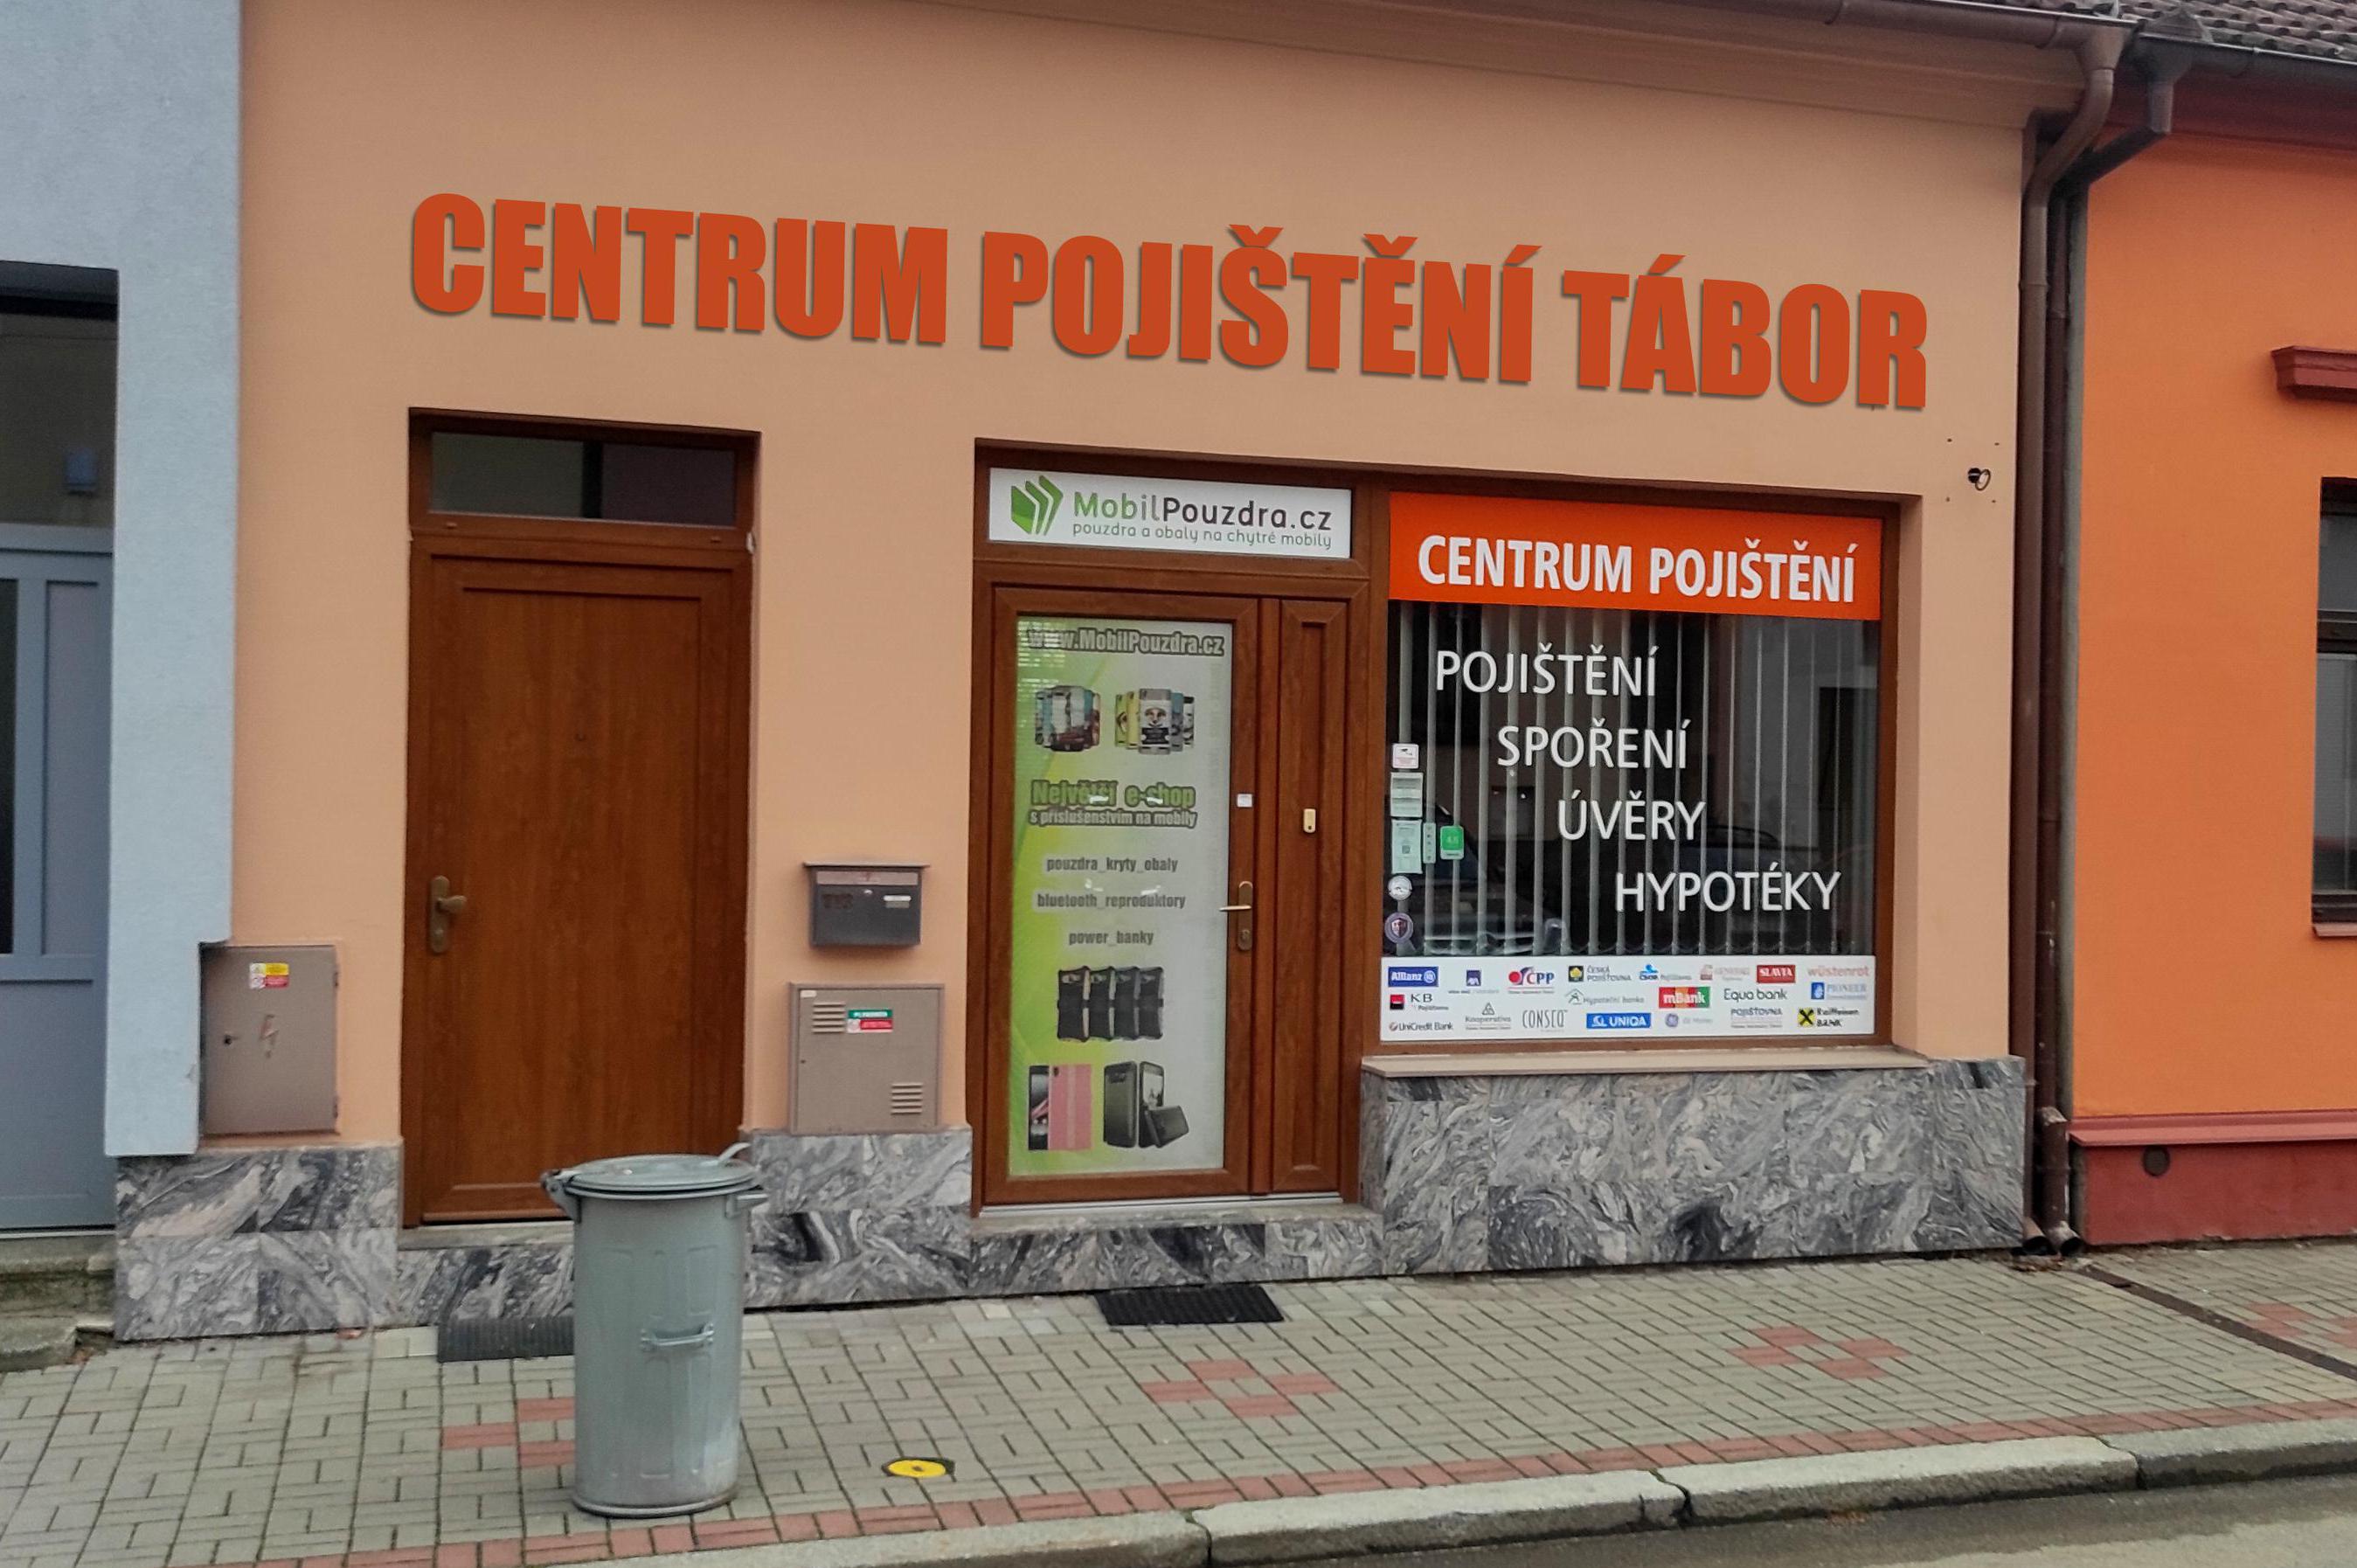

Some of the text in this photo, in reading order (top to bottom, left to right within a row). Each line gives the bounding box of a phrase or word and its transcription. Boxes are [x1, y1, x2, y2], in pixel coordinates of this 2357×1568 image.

[412, 193, 1927, 408] CENTRUM POJIŠTĚNÍ TÁBOR
[1074, 491, 1331, 531] MobilPouzdra.cz
[1073, 522, 1332, 550] pouzdra a obaly na chytré mobily
[1418, 535, 1859, 603] CENTRUM POJIŠTĚNÍ
[1029, 627, 1224, 656] www.MobilPouzdra.cz
[1436, 642, 1659, 697] POJIŠTĚNÍ
[1496, 718, 1692, 769] SPOŘENÍ
[1125, 782, 1196, 809] e-shop
[1153, 809, 1197, 829] mobily
[1557, 789, 1706, 841] ÚVĚRY
[1615, 862, 1842, 912] HYPOTÉKY
[1391, 971, 1423, 982] Allianz
[1411, 993, 1433, 1003] KB
[1662, 991, 1706, 1004] mBank
[1757, 989, 1788, 1000] bank
[1398, 1022, 1454, 1031] UniCredit Bank
[1609, 1015, 1647, 1027] UNIQA
